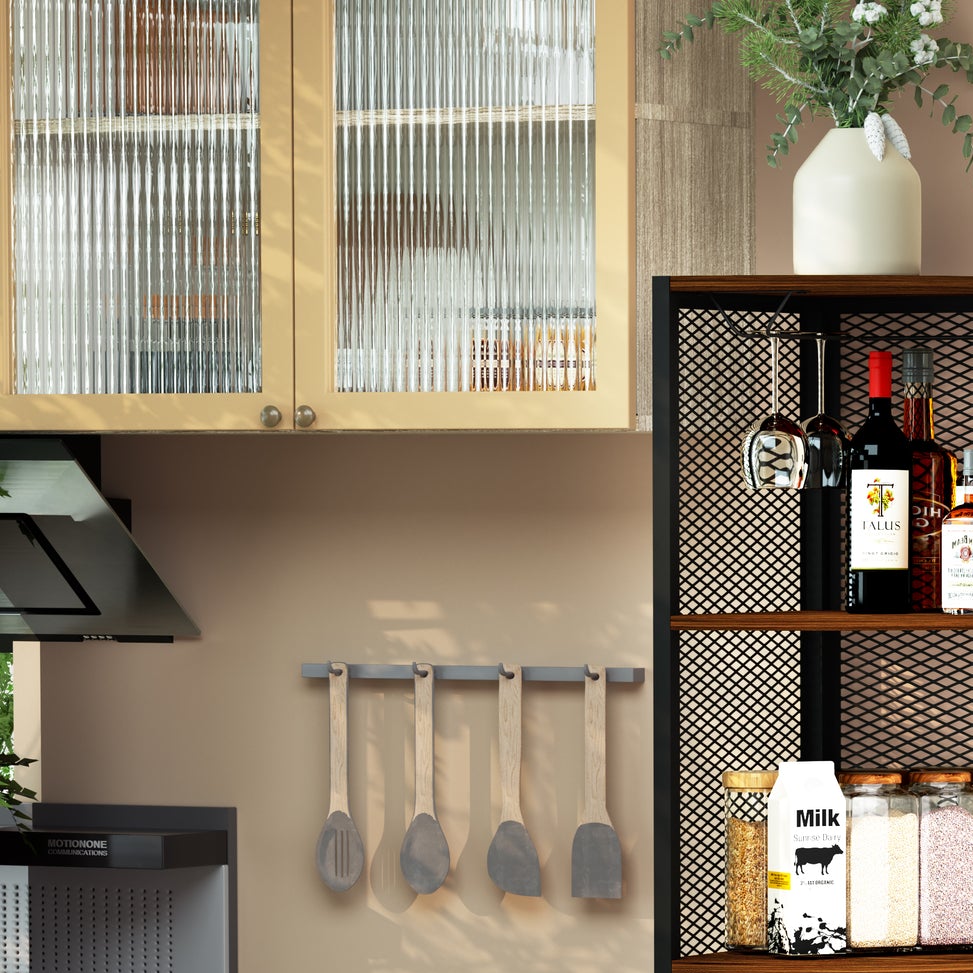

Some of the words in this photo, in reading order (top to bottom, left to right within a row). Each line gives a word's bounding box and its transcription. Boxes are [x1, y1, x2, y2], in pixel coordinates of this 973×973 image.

[863, 521, 900, 531] TALUS
[796, 809, 840, 828] Milk
[47, 839, 108, 849] MOTIONONE
[47, 848, 108, 857] COMMUNICATIONS
